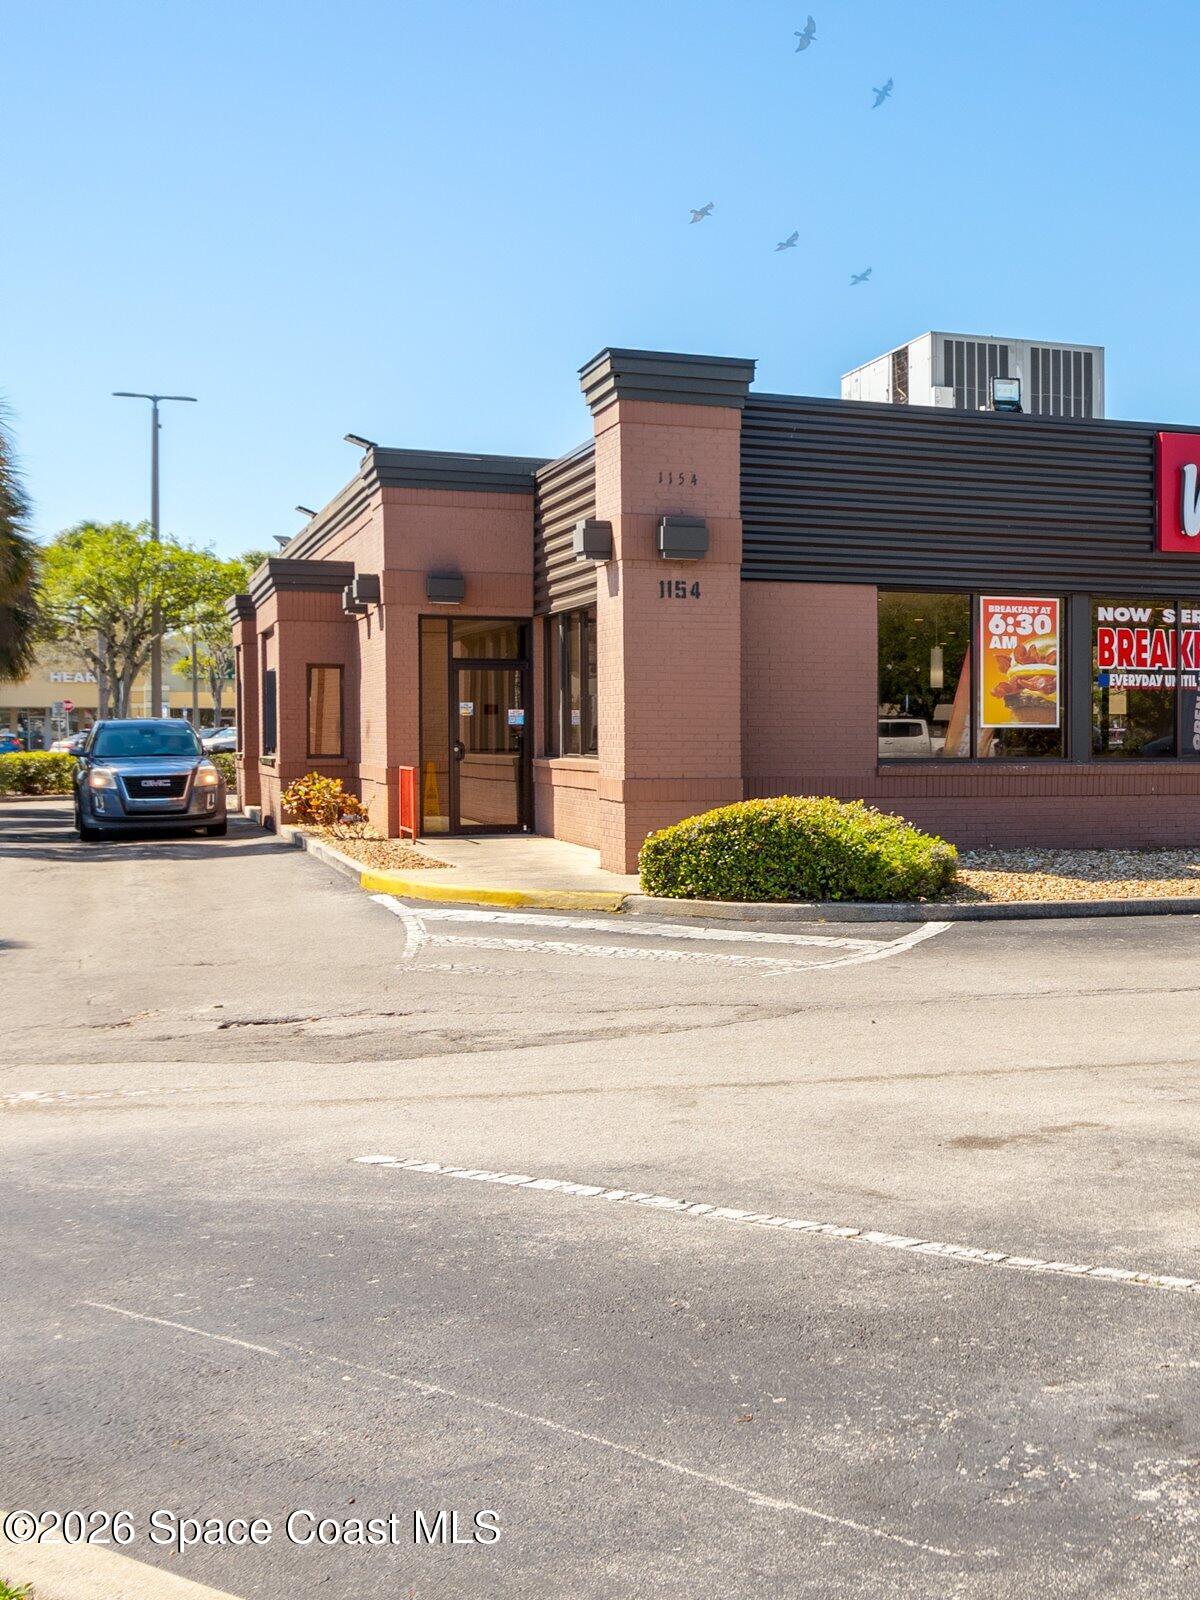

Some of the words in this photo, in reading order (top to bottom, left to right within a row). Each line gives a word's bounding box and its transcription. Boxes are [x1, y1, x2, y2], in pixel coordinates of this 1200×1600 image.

[659, 471, 698, 486] 1154
[659, 580, 701, 600] 1154
[988, 605, 1039, 614] BREAKFAST
[1040, 606, 1052, 614] AT
[1097, 607, 1152, 623] NOW
[988, 614, 1052, 635] 6:30
[989, 635, 1018, 649] AM
[1109, 673, 1164, 687] EVERYDAY
